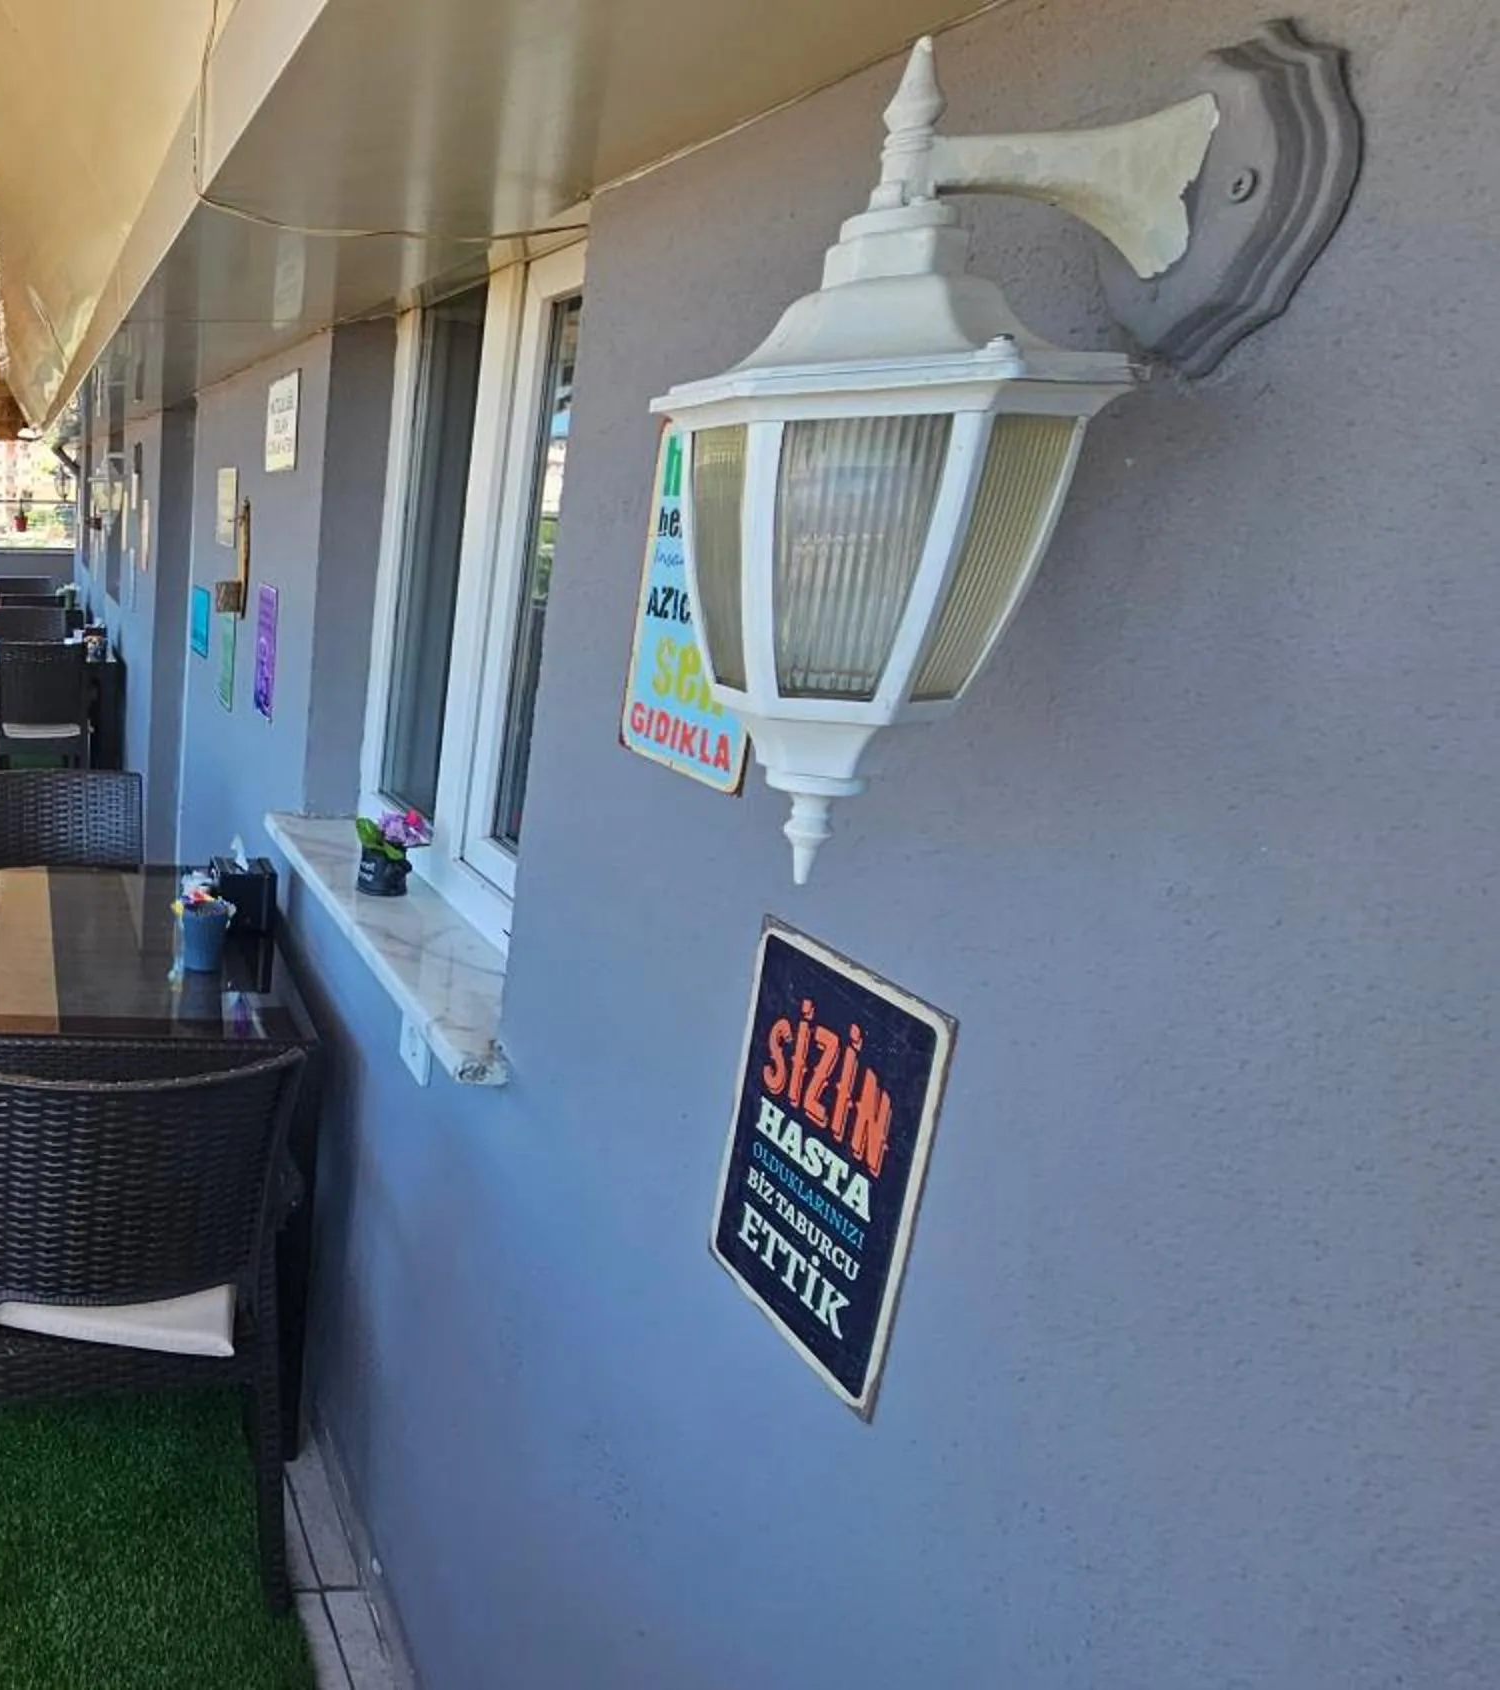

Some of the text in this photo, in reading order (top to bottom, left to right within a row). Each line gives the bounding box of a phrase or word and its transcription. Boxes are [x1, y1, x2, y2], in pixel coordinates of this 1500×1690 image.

[657, 506, 683, 539] he
[646, 586, 694, 626] AZIC
[630, 702, 730, 773] GIDIKLA
[763, 999, 893, 1178] SİZİN
[752, 1141, 866, 1251] OLDUKLARINIZI
[756, 1096, 871, 1223] HASTA
[737, 1201, 851, 1340] ETTİK
[747, 1165, 861, 1282] BİZ TABURCU
